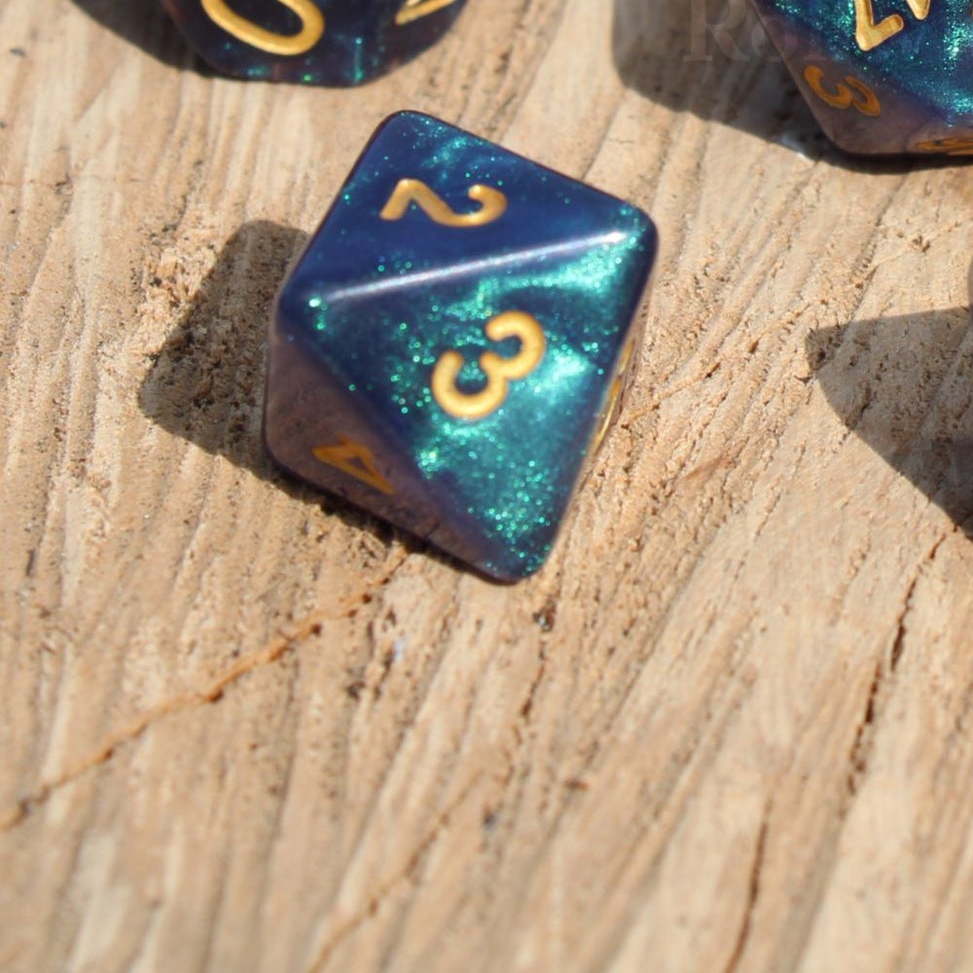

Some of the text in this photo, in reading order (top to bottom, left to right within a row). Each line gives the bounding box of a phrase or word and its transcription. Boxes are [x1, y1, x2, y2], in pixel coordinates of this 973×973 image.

[804, 64, 882, 117] 3
[379, 178, 508, 227] 2
[431, 310, 546, 420] 3
[311, 437, 395, 495] 4
